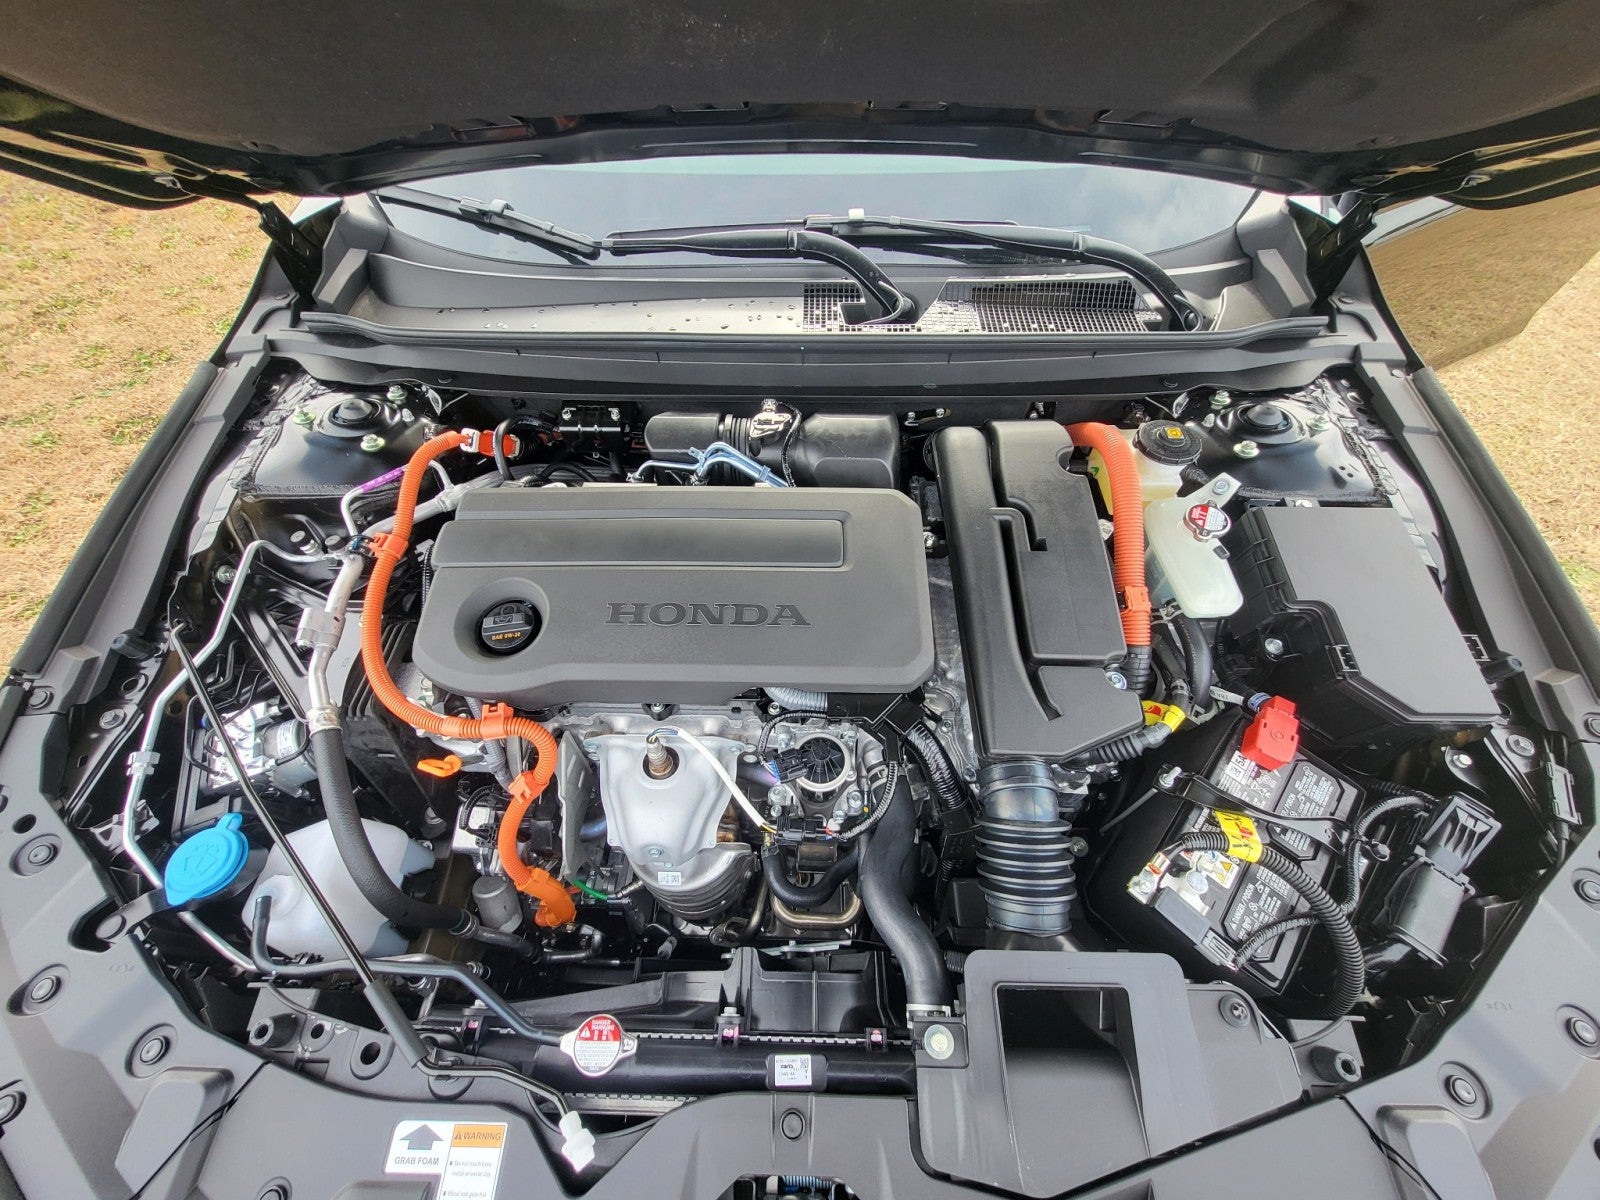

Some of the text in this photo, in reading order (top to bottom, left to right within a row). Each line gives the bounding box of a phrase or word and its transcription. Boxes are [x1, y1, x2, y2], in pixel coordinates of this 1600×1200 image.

[605, 602, 812, 627] HONDA
[463, 1132, 502, 1141] WARNING
[394, 1156, 440, 1166] GRAB FOAM
